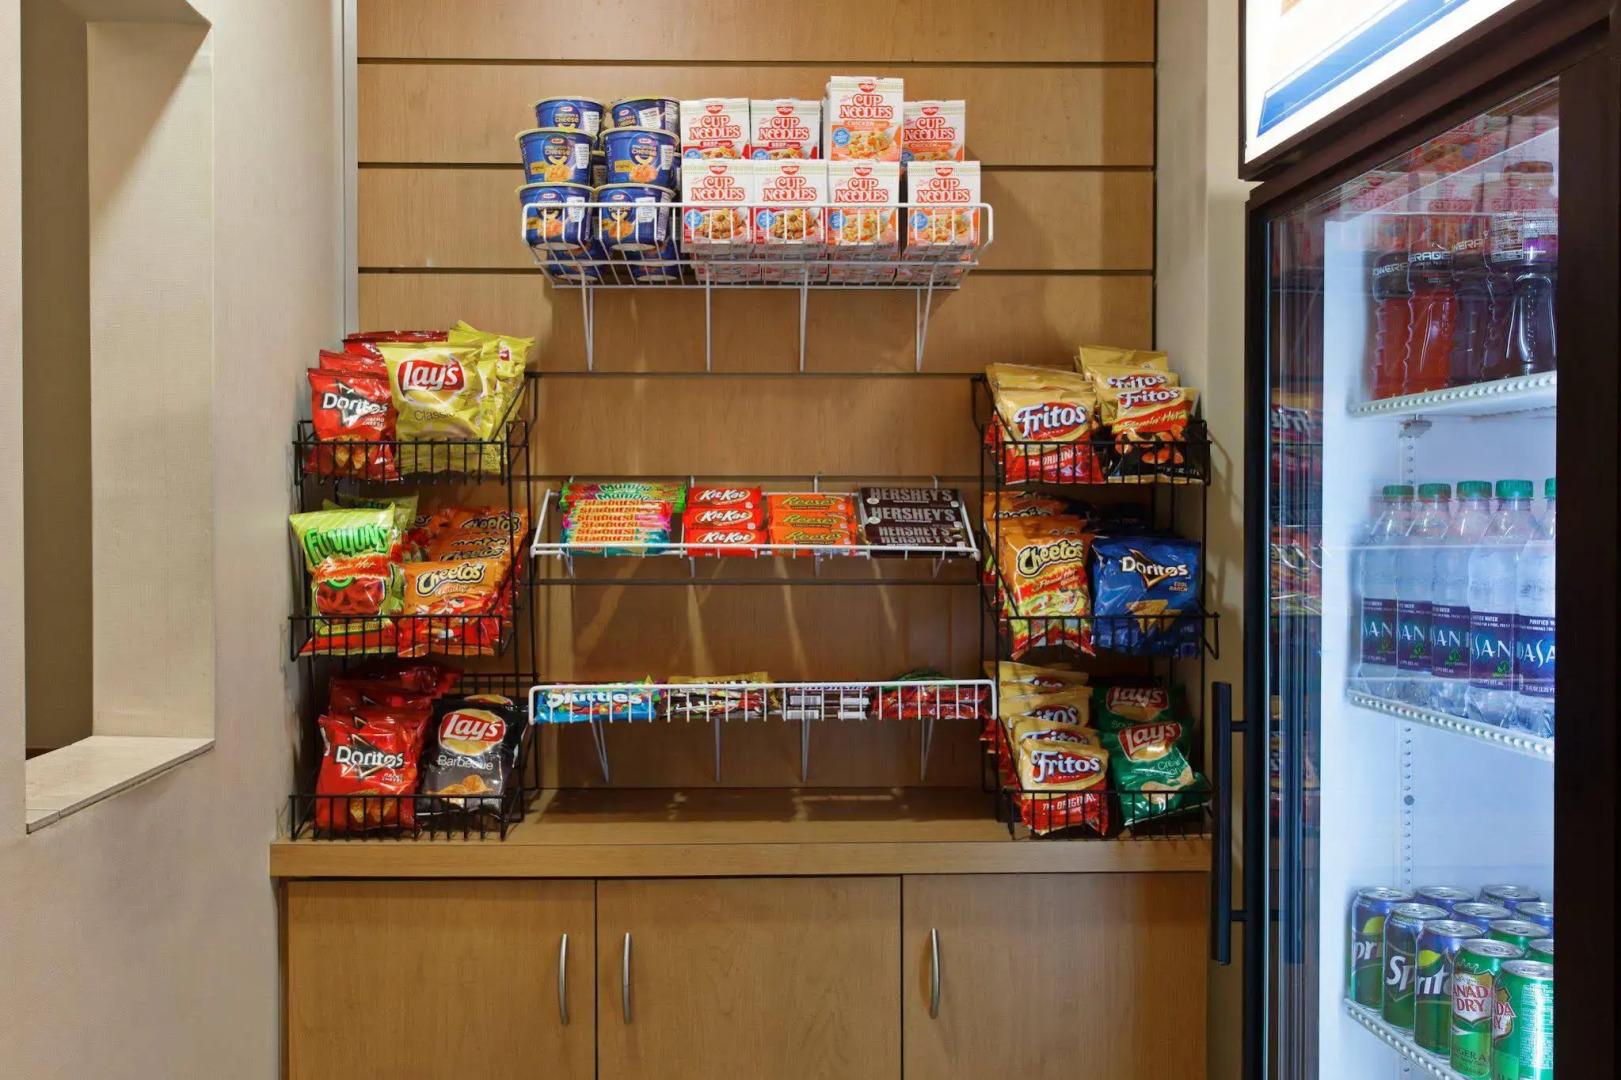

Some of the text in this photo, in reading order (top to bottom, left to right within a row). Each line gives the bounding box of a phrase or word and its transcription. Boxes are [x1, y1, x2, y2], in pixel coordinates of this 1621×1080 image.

[852, 94, 883, 106] CUP
[840, 106, 894, 119] NOODLES
[701, 116, 730, 127] CUP
[771, 117, 800, 128] CUP
[916, 117, 946, 129] CUP
[690, 125, 741, 140] NOODLES
[758, 127, 810, 140] NOODLES
[904, 128, 956, 141] NOODLES
[704, 176, 734, 188] CUP
[776, 176, 806, 189] CUP
[848, 178, 878, 190] CUP
[929, 178, 960, 190] CUP
[691, 187, 746, 201] NOODLES
[763, 188, 817, 202] NOODLES
[835, 189, 889, 202] NOODLES
[917, 189, 970, 202] NOODLES
[403, 361, 460, 392] Lay's
[1107, 375, 1166, 389] Fritos
[322, 392, 388, 414] Doritos
[1116, 389, 1179, 408] Fritos
[414, 410, 456, 421] Classic
[1014, 403, 1086, 438] Fritos
[1161, 411, 1183, 422] Hot
[600, 484, 654, 492] Mamba
[870, 488, 952, 501] HERSHEY'S
[782, 496, 836, 506] Reese's
[783, 514, 838, 524] Reese's
[872, 508, 956, 522] HERSHEY'S
[785, 531, 842, 541] Reese's
[1018, 540, 1084, 578] Cheetos
[1122, 556, 1188, 576] Doritos
[416, 562, 486, 596] Cheetos
[546, 692, 642, 708] Skittles
[1112, 688, 1164, 707] Lay's
[443, 714, 502, 740] Lay's
[336, 745, 404, 768] Doritos
[438, 755, 494, 770] Barbecue
[1031, 750, 1102, 783] Fritos
[1457, 998, 1485, 1012] DRY
